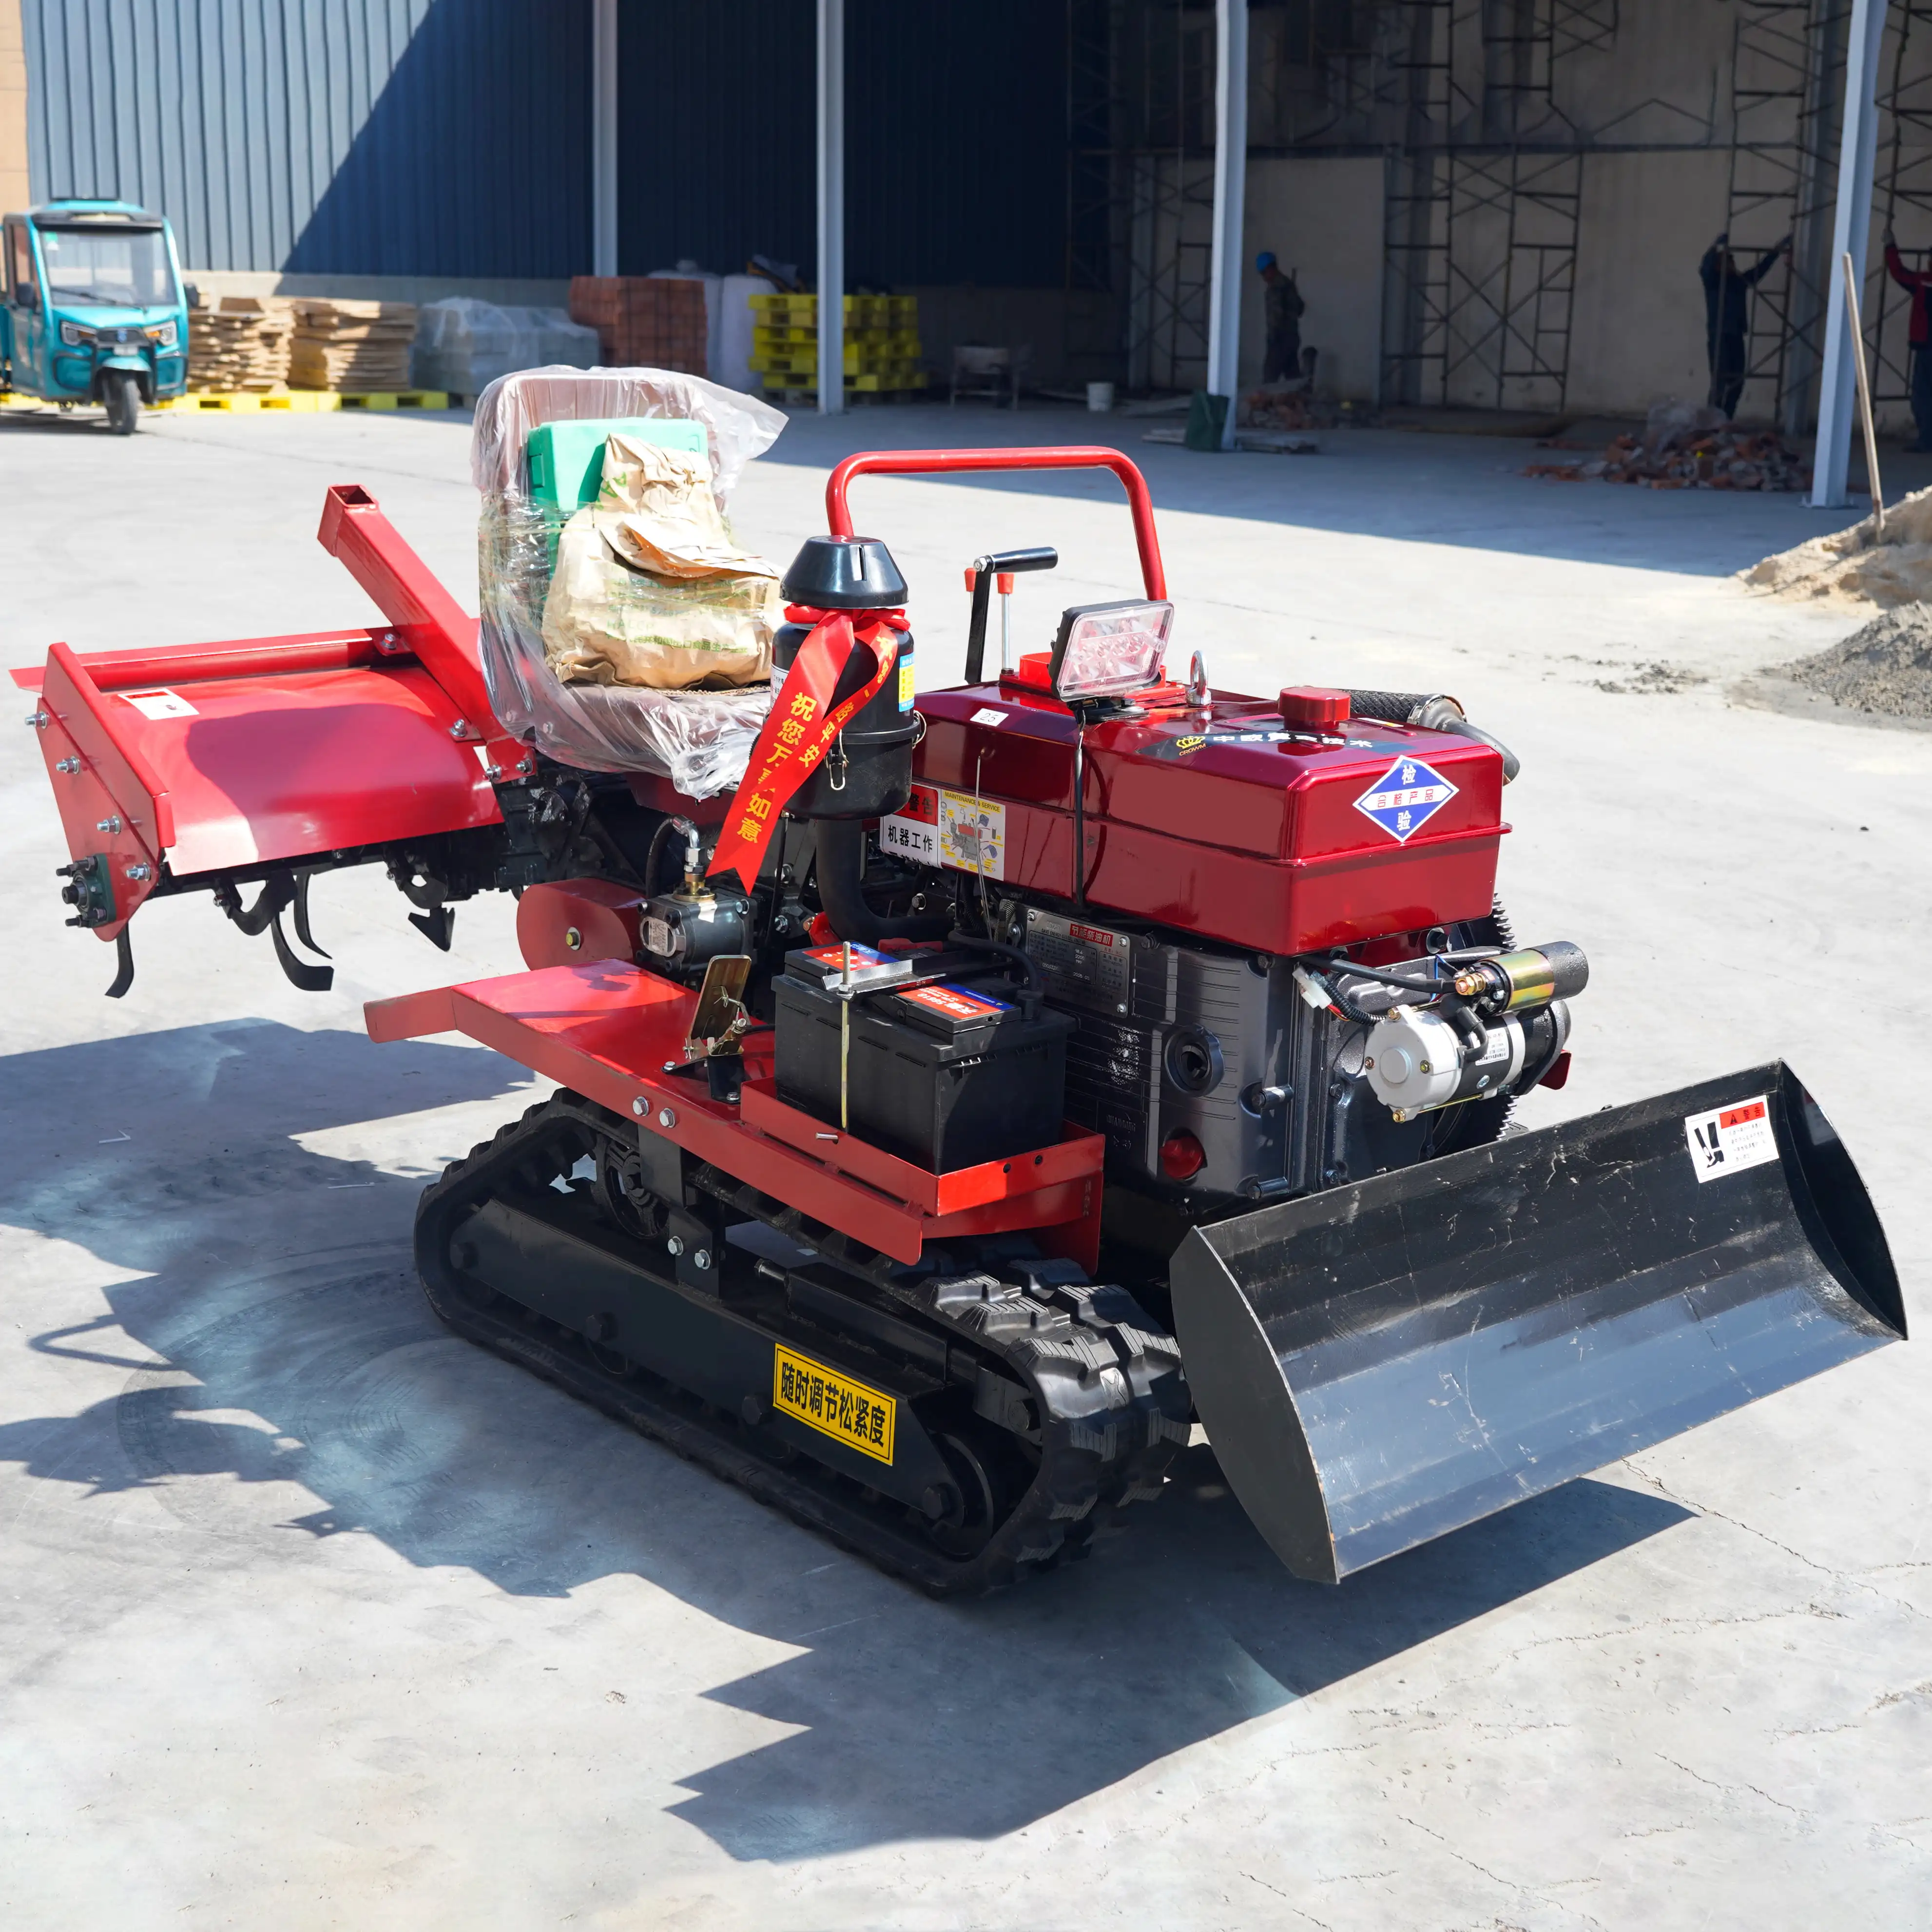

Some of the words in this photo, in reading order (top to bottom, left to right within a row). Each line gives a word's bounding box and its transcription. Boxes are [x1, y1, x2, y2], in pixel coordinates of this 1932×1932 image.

[980, 713, 999, 722] 25
[1402, 764, 1416, 785] 检
[909, 793, 934, 816] 警告
[945, 791, 977, 805] MAINTENANCE
[982, 802, 1001, 812] SERVICE
[1377, 789, 1434, 808] 合格产品
[1396, 810, 1411, 831] 验
[888, 825, 933, 853] 机器工作
[1072, 926, 1111, 945] 节能柴油机
[1742, 1106, 1761, 1121] 警告
[781, 1361, 886, 1448] 随时调节松紧度
